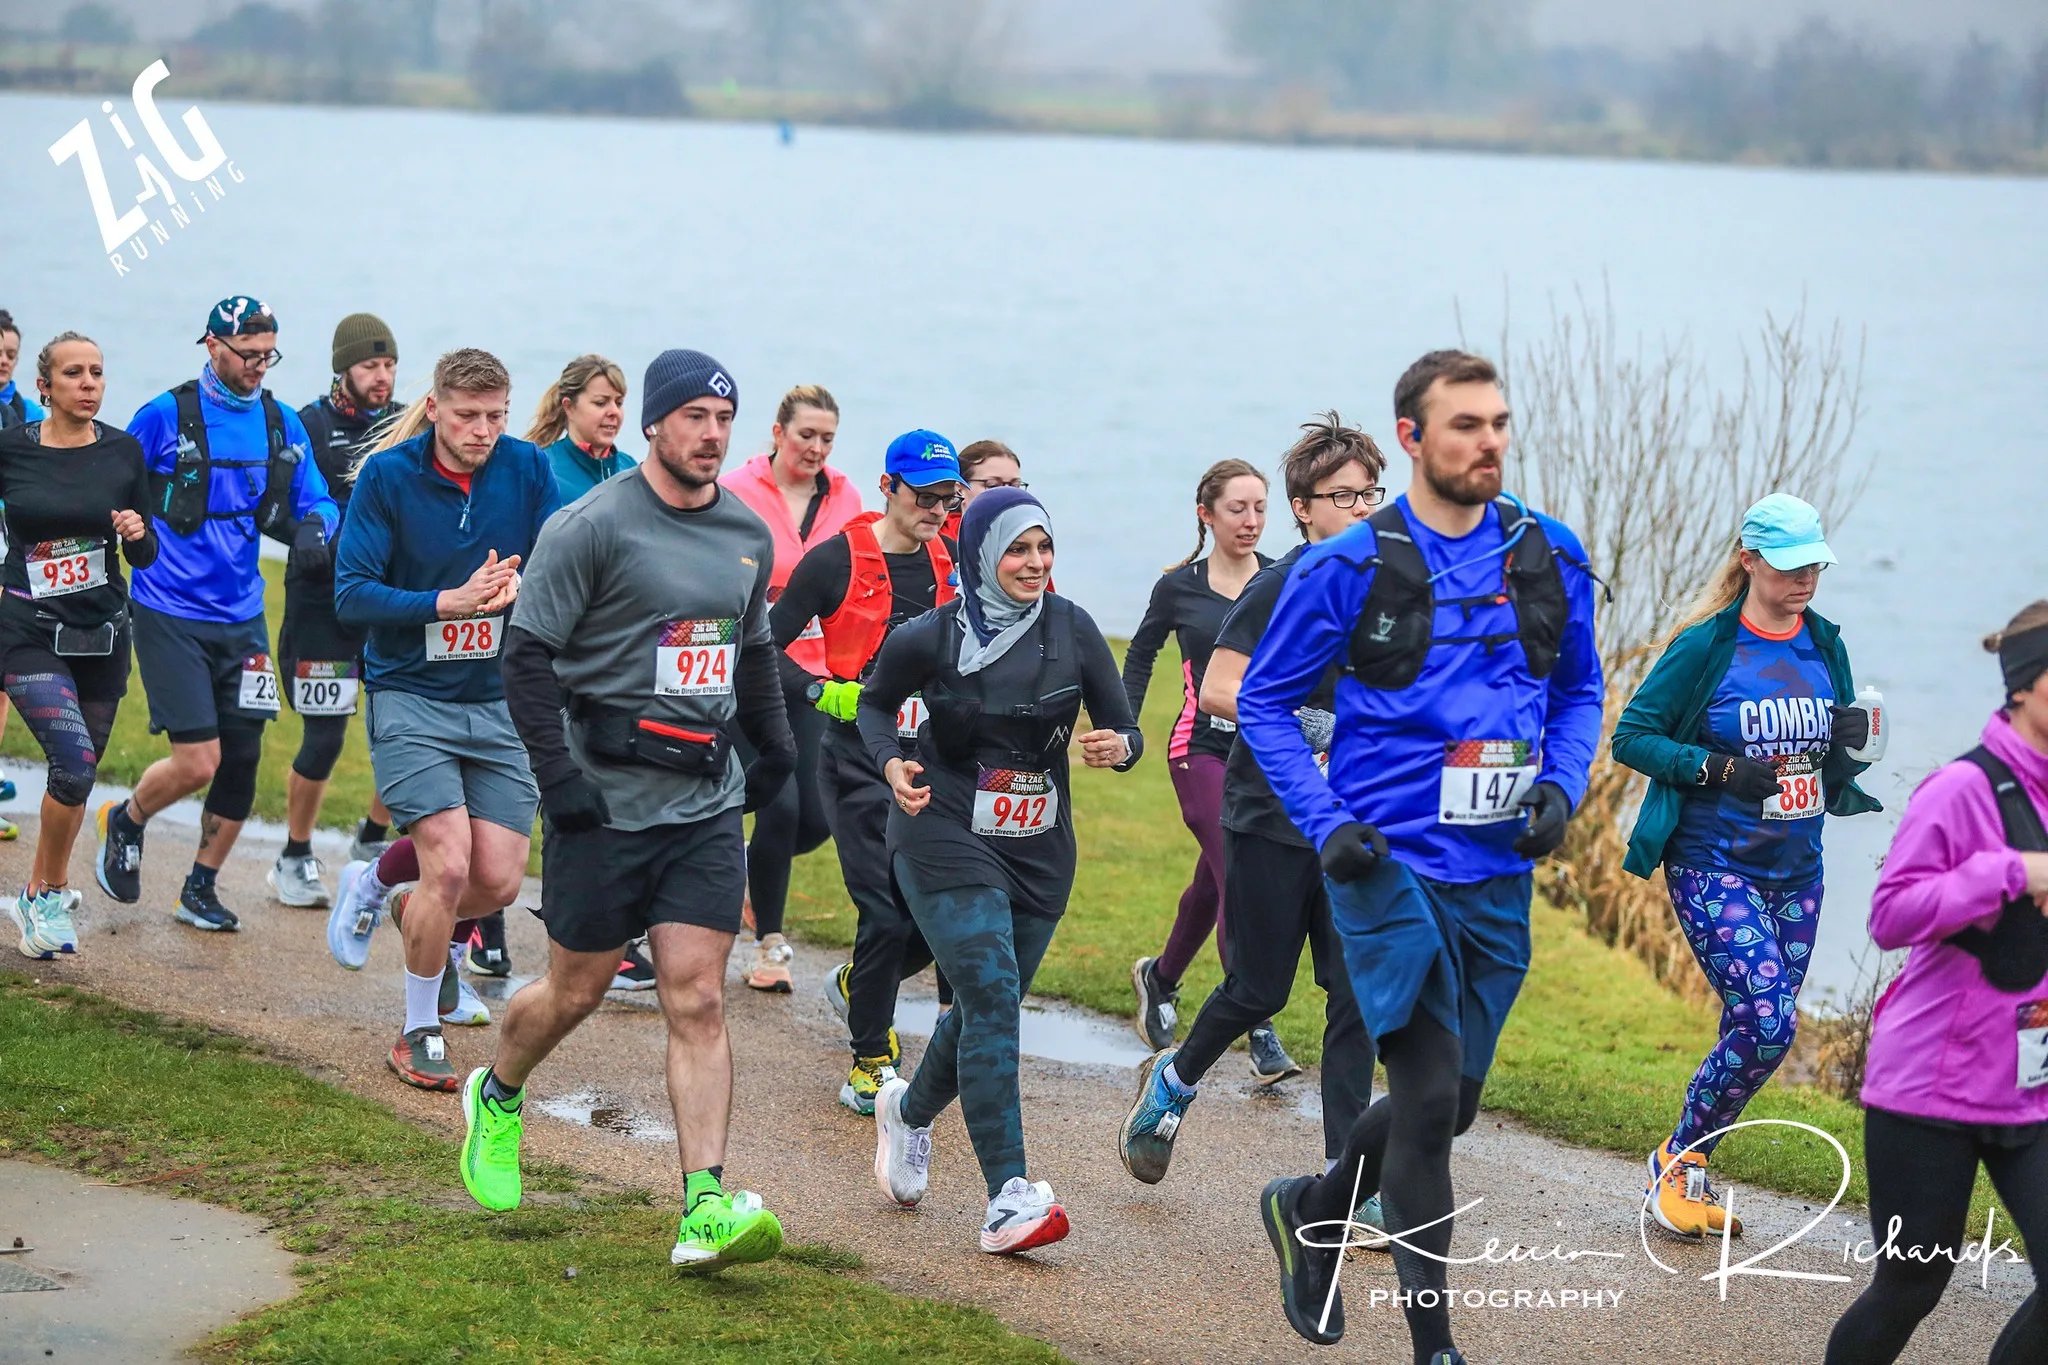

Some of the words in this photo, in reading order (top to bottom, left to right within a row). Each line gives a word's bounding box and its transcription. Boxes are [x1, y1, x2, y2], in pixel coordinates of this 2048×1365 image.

[43, 556, 90, 589] 933
[443, 621, 493, 652] 928
[693, 623, 704, 633] ZIG
[705, 623, 718, 632] ZAG
[691, 632, 721, 643] RUNNING
[677, 649, 727, 685] 924
[301, 682, 341, 705] 209
[664, 687, 679, 695] Race
[1788, 755, 1800, 764] ZIG
[1010, 782, 1044, 792] RUNNING
[1013, 773, 1027, 783] ZIG
[1028, 775, 1043, 784] ZAG
[1471, 772, 1520, 809] 147
[993, 796, 1048, 828] 942
